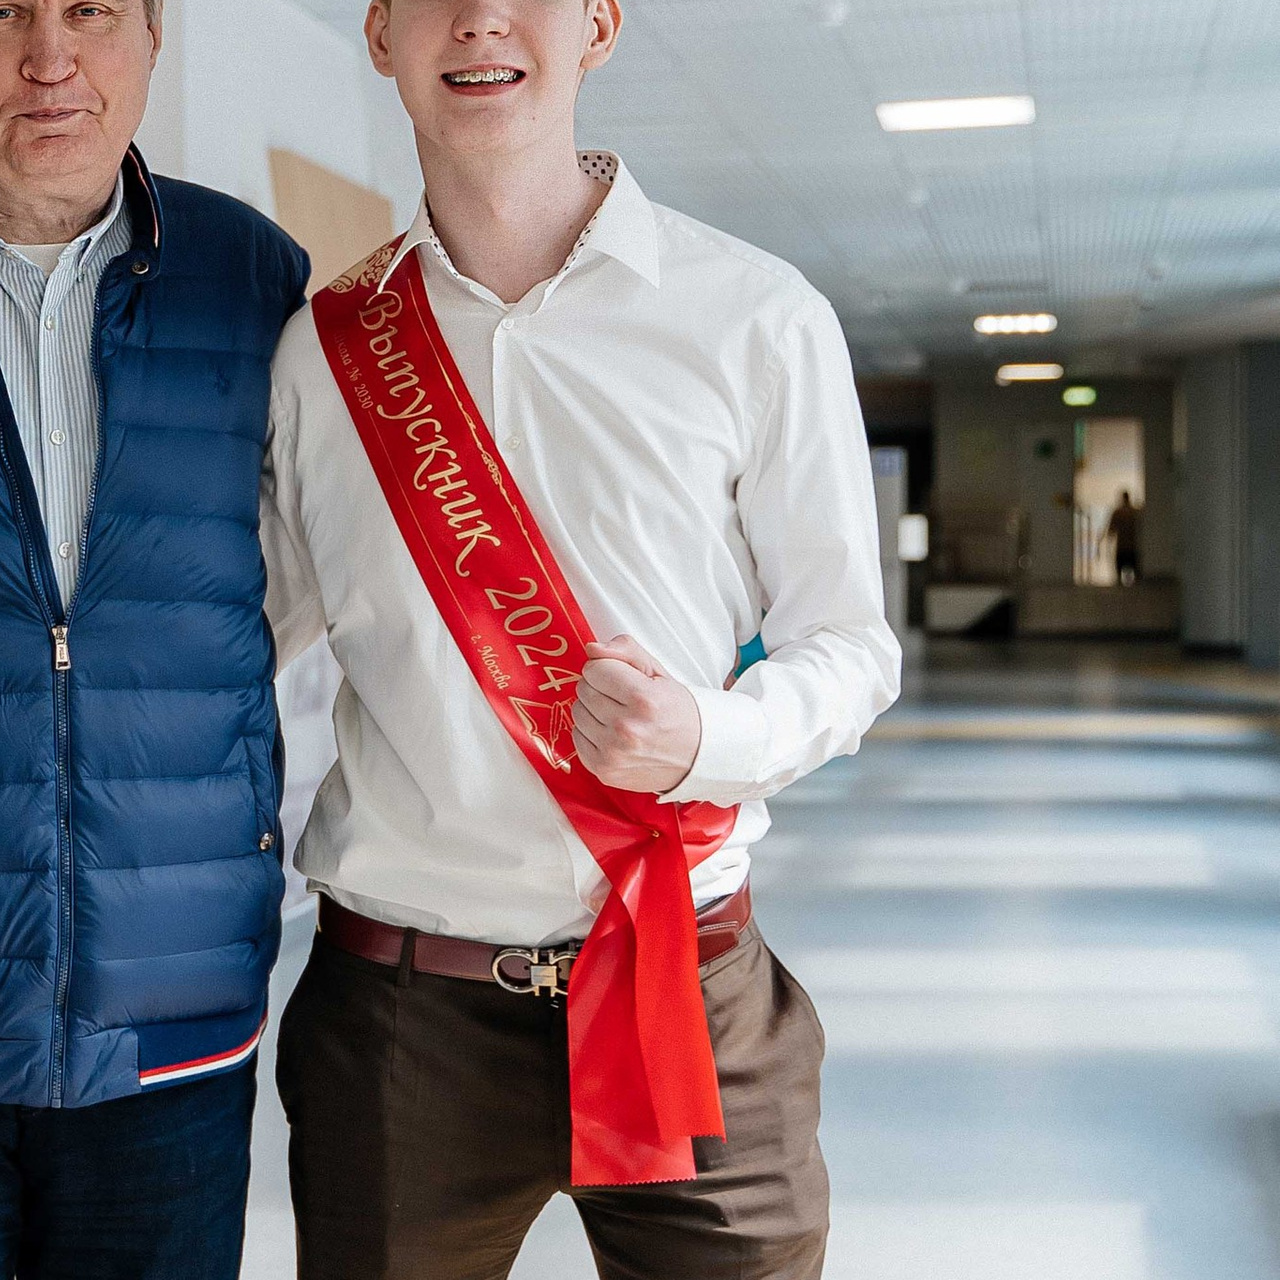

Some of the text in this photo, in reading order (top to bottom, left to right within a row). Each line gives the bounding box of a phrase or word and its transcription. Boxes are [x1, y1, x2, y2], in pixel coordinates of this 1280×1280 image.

[354, 383, 375, 411] 2030
[357, 290, 583, 692] Выпускник 2024
[477, 645, 510, 691] Москва
